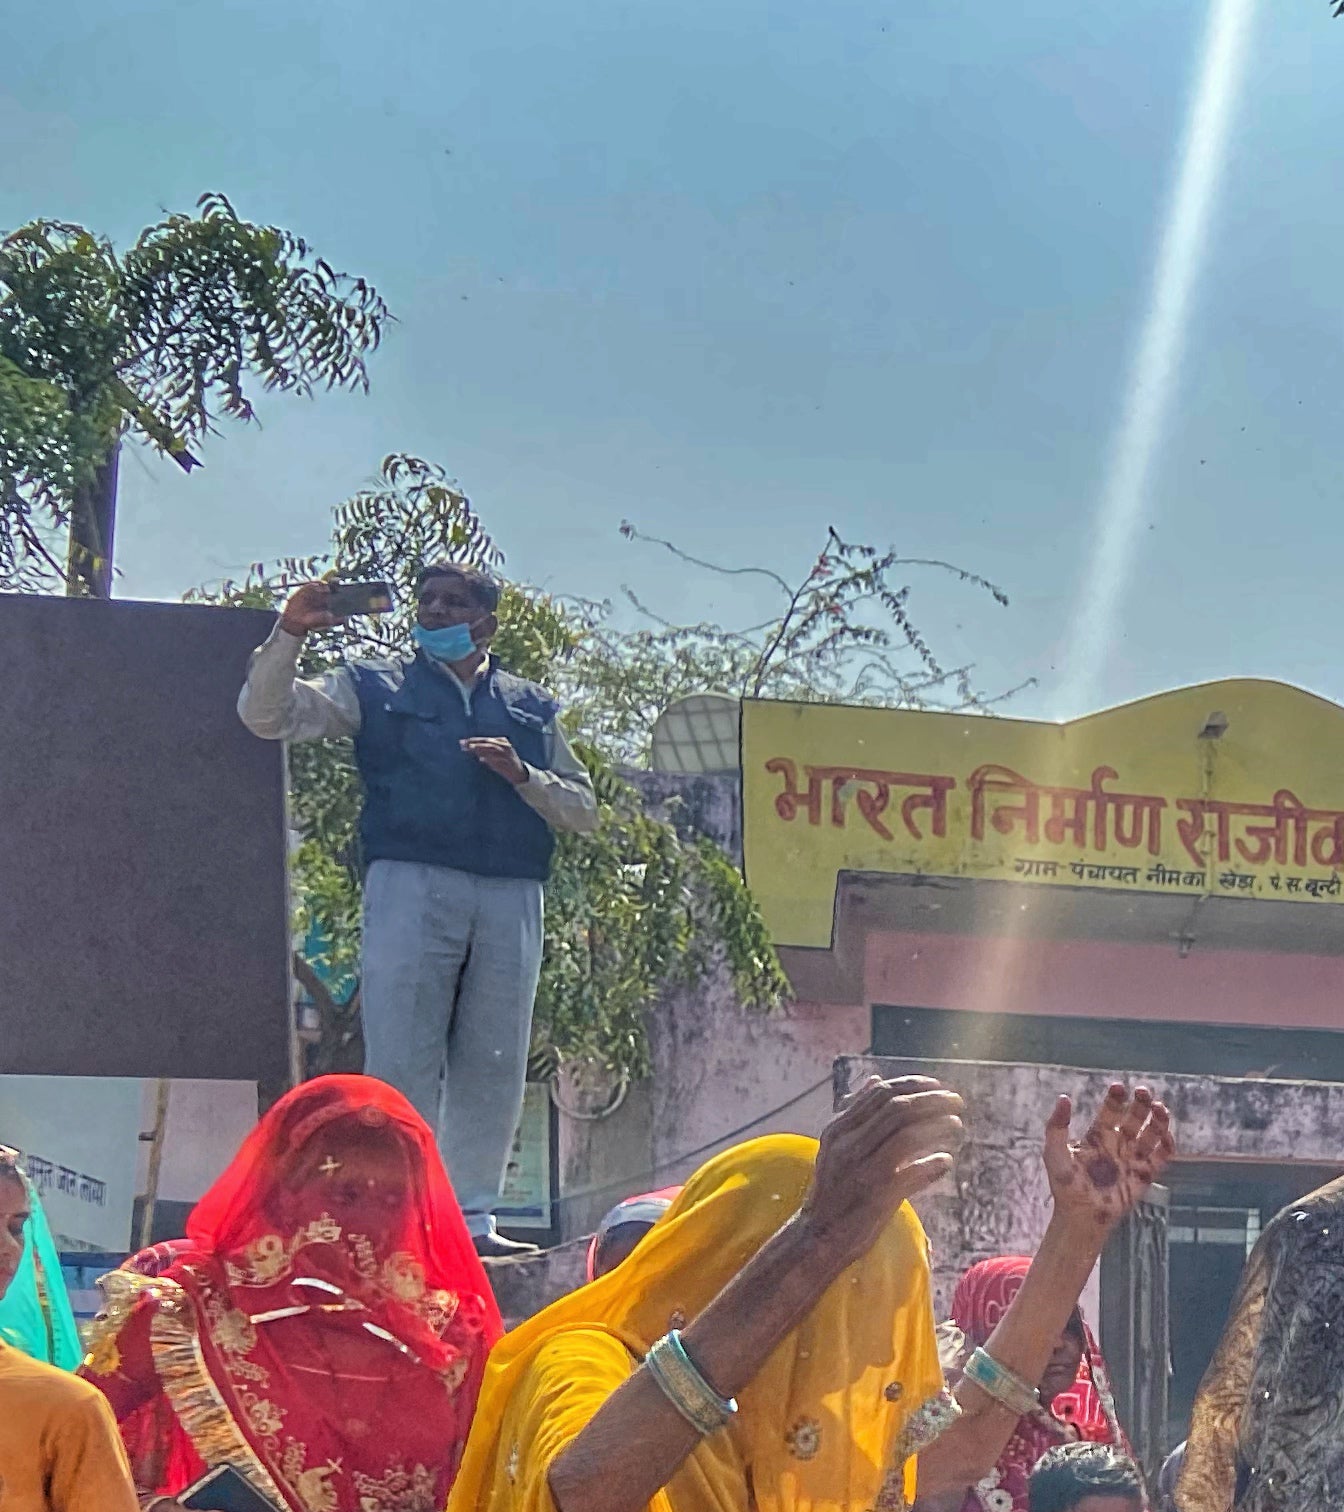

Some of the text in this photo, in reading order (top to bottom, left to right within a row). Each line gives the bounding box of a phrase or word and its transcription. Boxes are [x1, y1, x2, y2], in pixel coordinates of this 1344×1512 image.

[765, 757, 956, 841] भारत
[966, 764, 1168, 857] निर्माण
[1069, 858, 1141, 885] पंचायत
